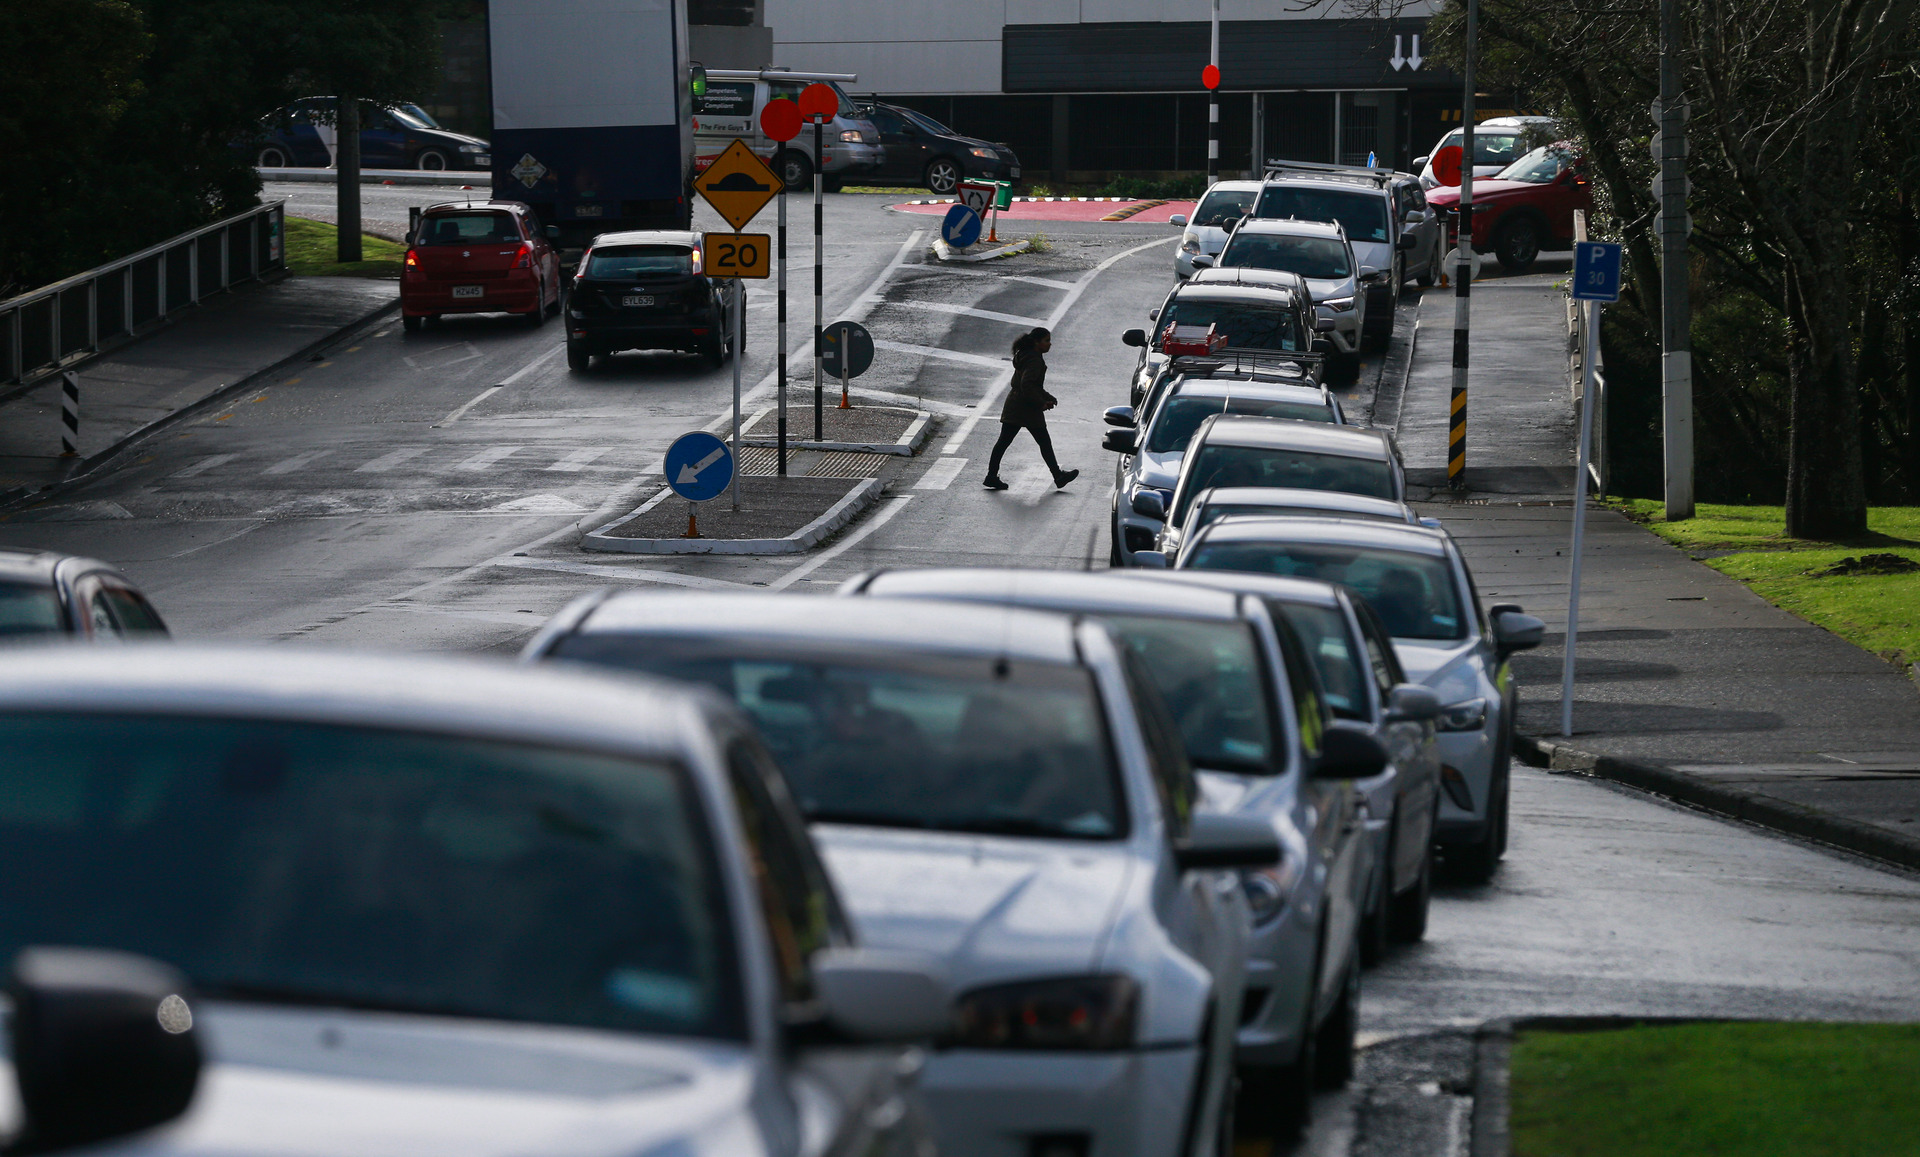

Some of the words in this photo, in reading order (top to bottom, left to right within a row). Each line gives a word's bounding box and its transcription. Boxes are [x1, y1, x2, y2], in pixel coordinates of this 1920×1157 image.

[728, 124, 743, 132] Guys
[718, 243, 757, 268] 20
[1591, 246, 1606, 263] P
[1588, 271, 1605, 285] 30
[455, 287, 480, 296] HZW45
[623, 296, 654, 305] EYL639
